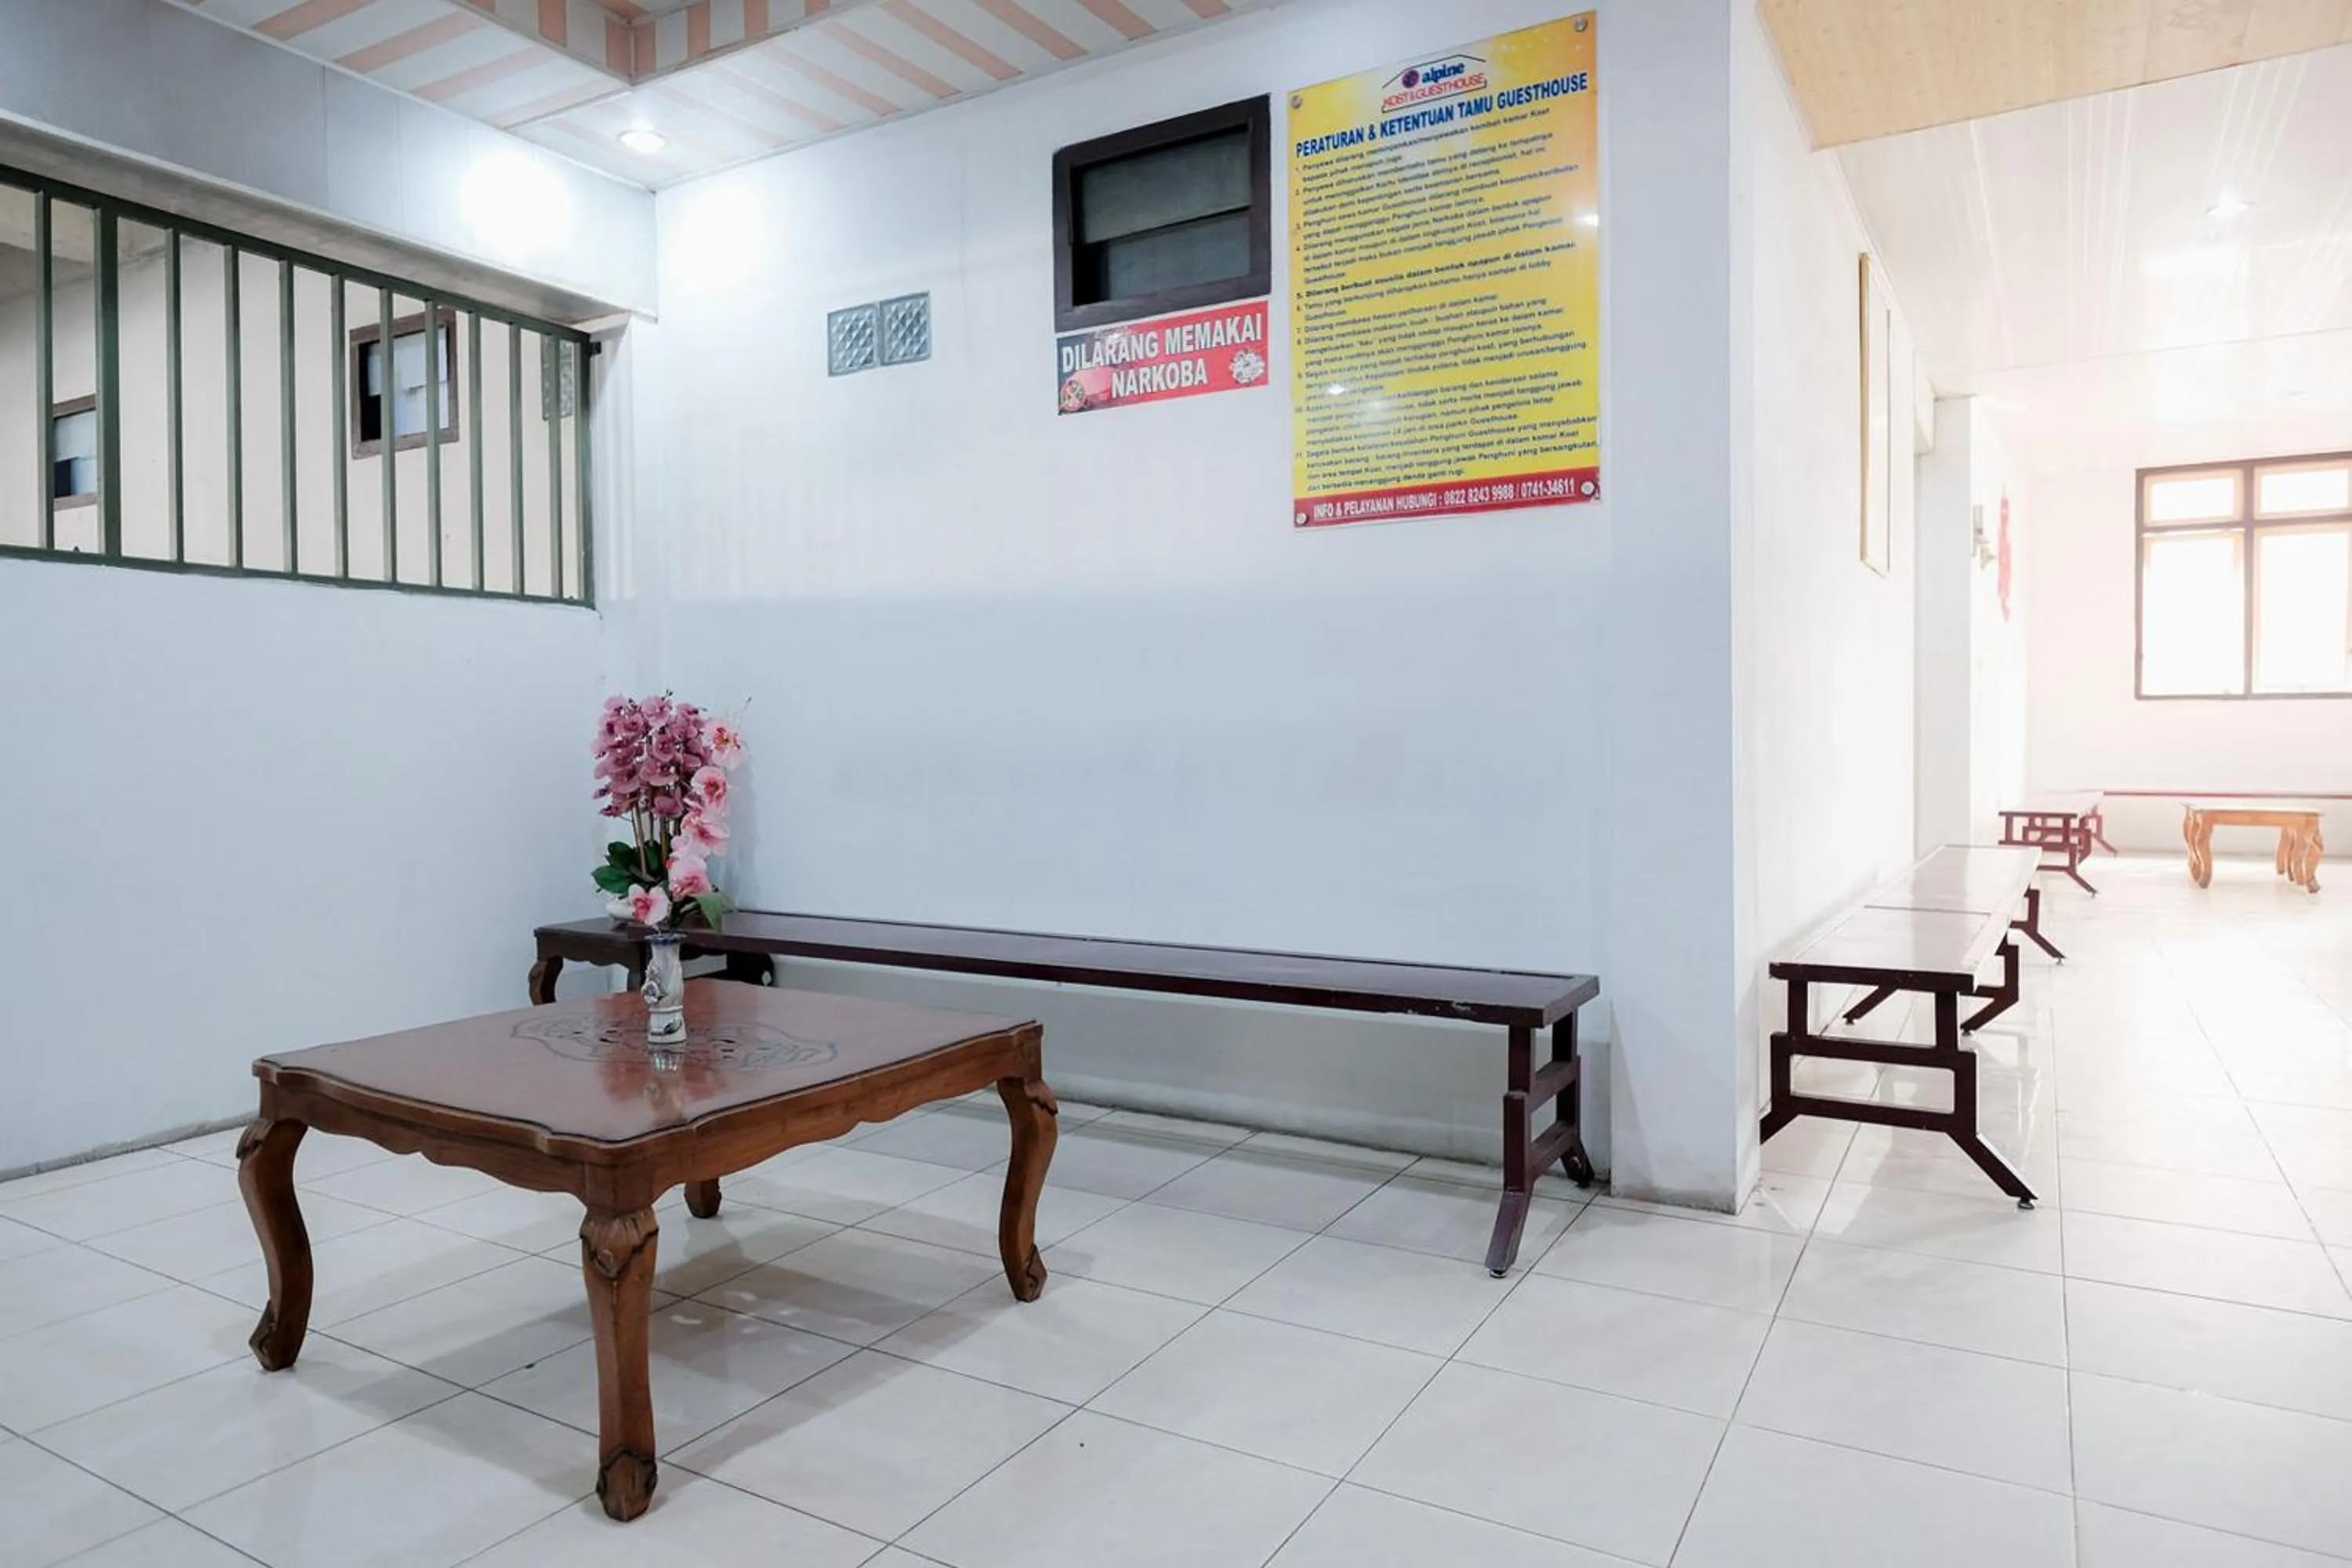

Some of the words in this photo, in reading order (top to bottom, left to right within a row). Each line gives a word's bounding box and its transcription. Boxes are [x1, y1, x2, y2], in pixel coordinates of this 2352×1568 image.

[1421, 63, 1465, 84] alpine
[1295, 125, 1365, 158] PERATURAN
[1367, 124, 1377, 141] &
[1379, 105, 1454, 139] KETENTUAN
[1457, 96, 1494, 119] TAMU
[1497, 73, 1588, 110] GUESTHOUSE
[1062, 332, 1159, 373] DILARANG
[1164, 313, 1262, 355] MEMAKAI
[1110, 358, 1209, 399] NARKOBA
[1313, 504, 1334, 520] INFO
[1334, 503, 1343, 517] &
[1344, 498, 1393, 517] PELAYANAN
[1396, 492, 1437, 512] HUBUNGI
[1443, 489, 1466, 506] 0822
[1467, 486, 1490, 503] 8243
[1520, 477, 1576, 498] 0741-34611
